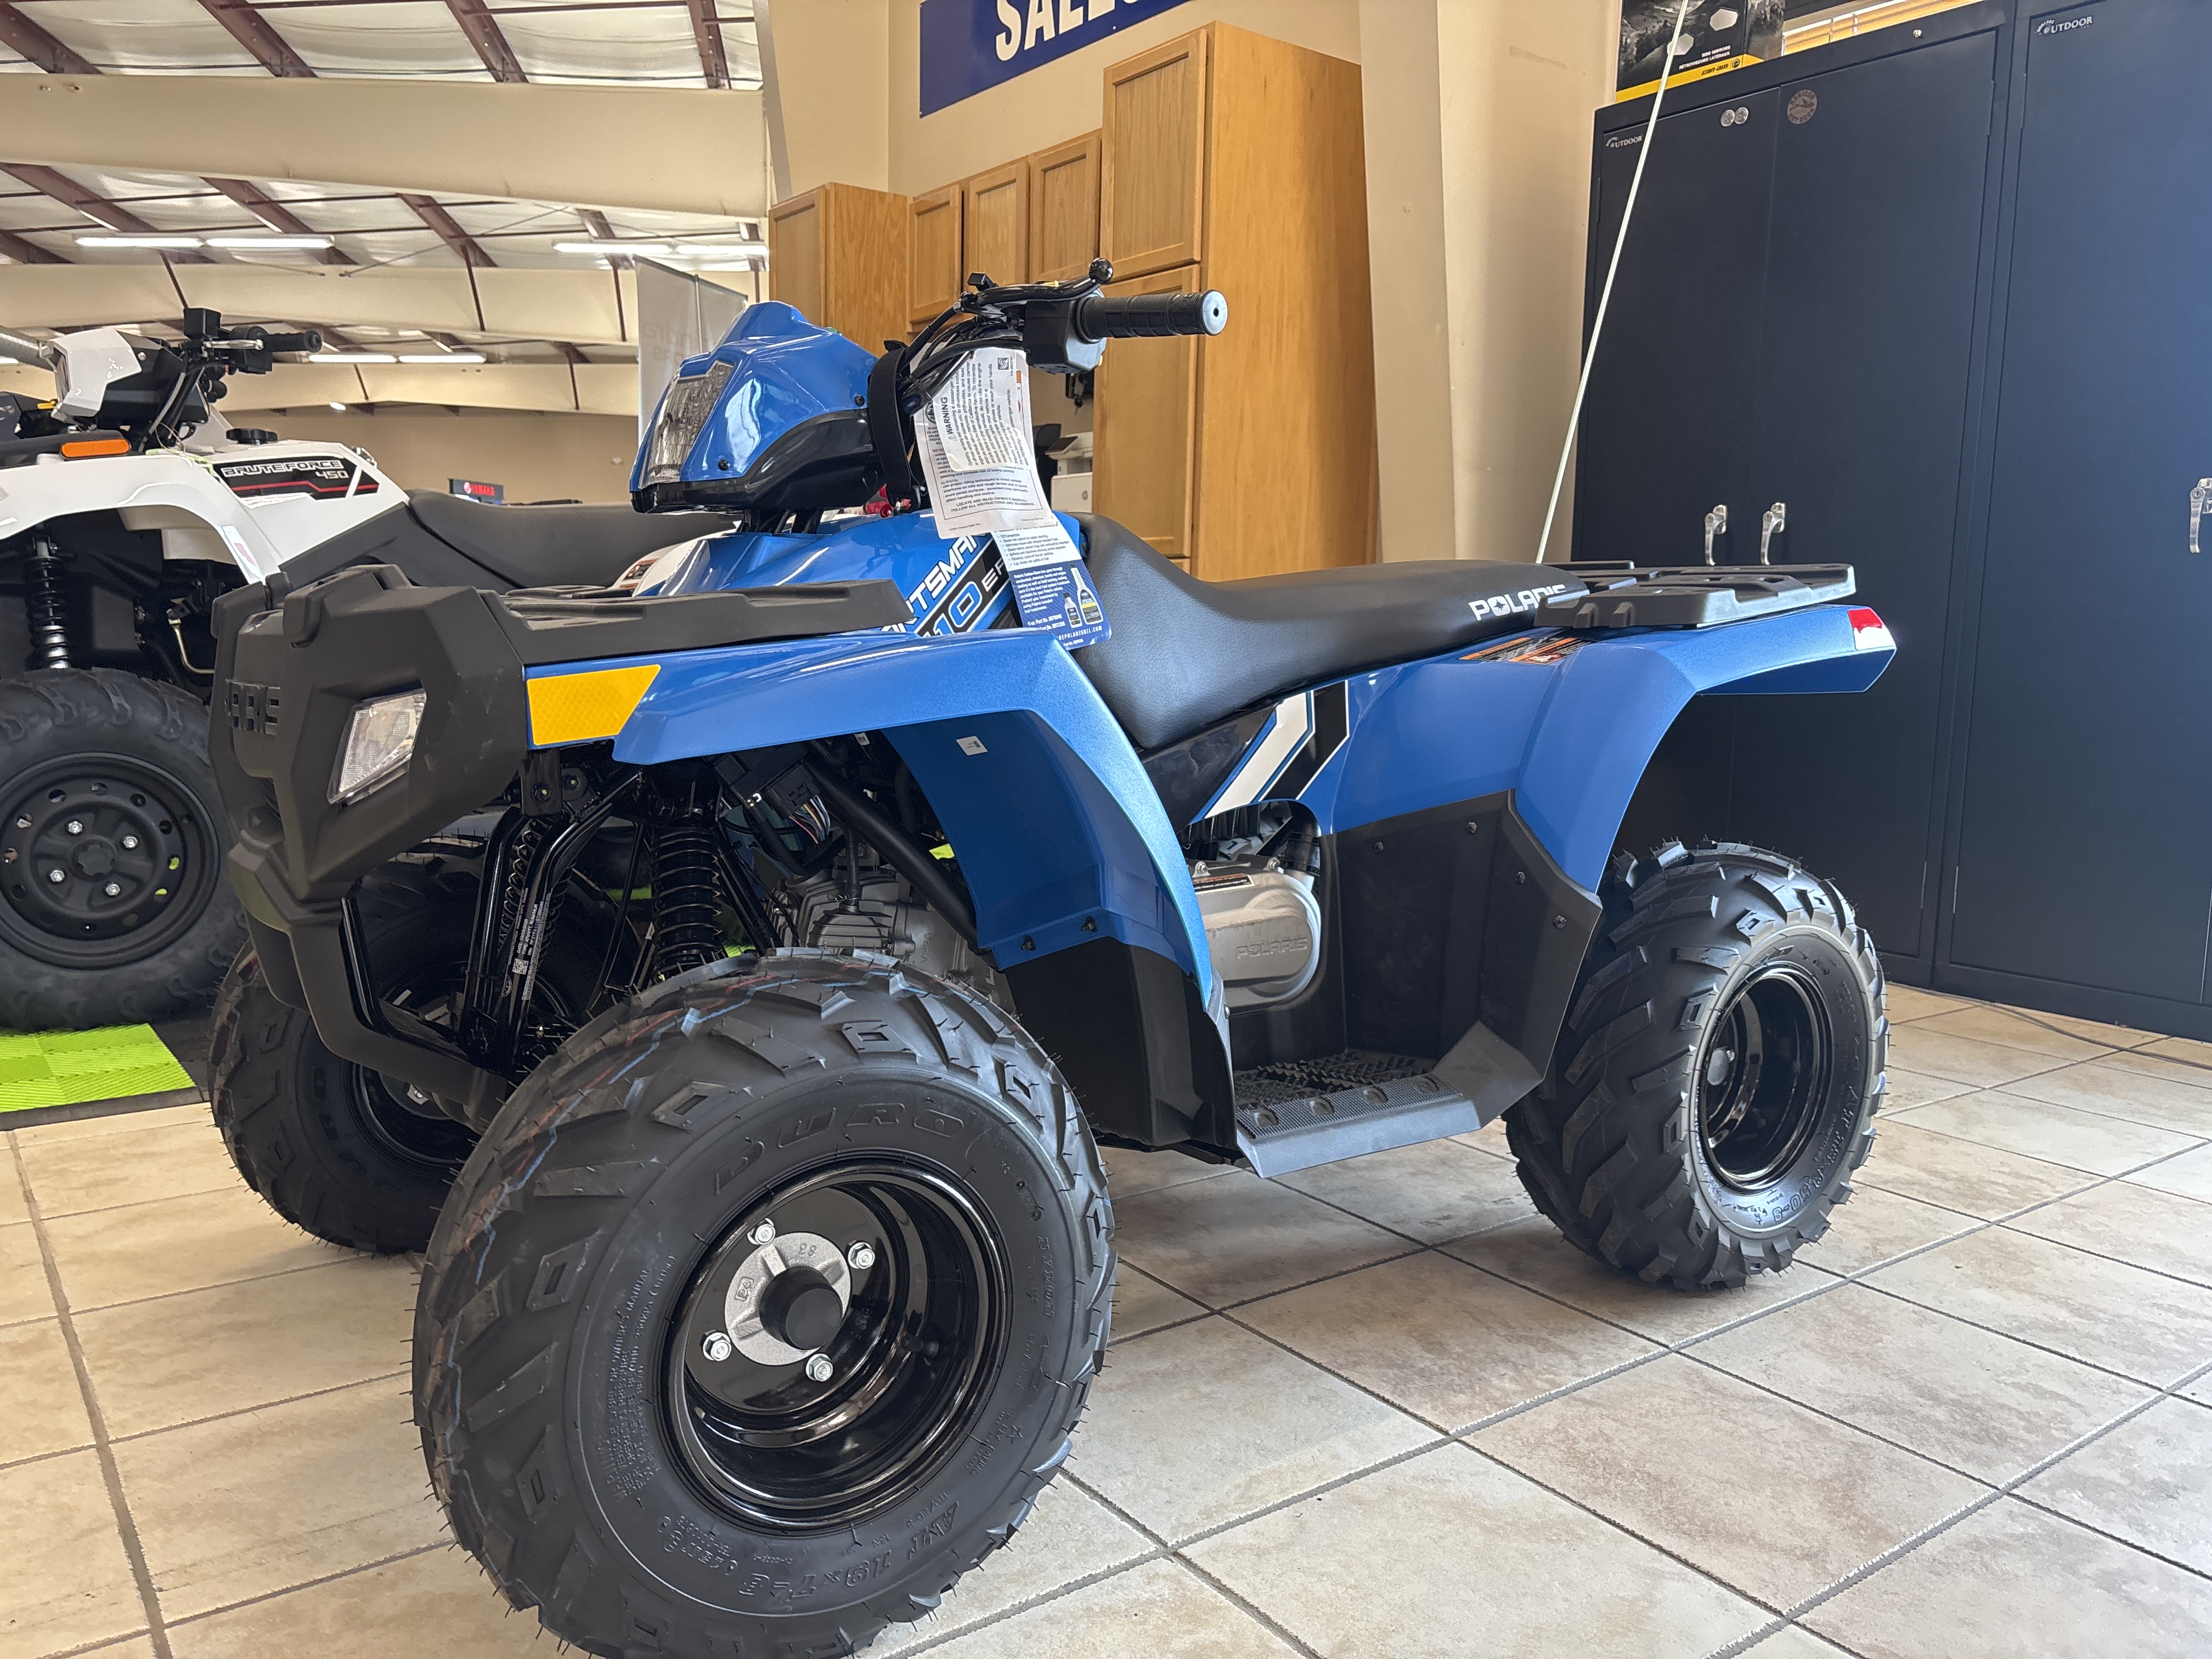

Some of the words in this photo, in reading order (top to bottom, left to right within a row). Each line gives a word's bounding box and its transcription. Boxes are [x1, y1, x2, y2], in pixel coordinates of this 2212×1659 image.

[942, 397, 953, 435] WARNING
[221, 463, 284, 477] BRUTE
[284, 460, 345, 472] FORCE
[315, 470, 349, 479] 450
[981, 556, 1005, 592] EF
[1057, 625, 1102, 640] REPOLARISOIL.COM
[1237, 937, 1307, 959] POLARIS
[715, 1103, 964, 1195] DURO
